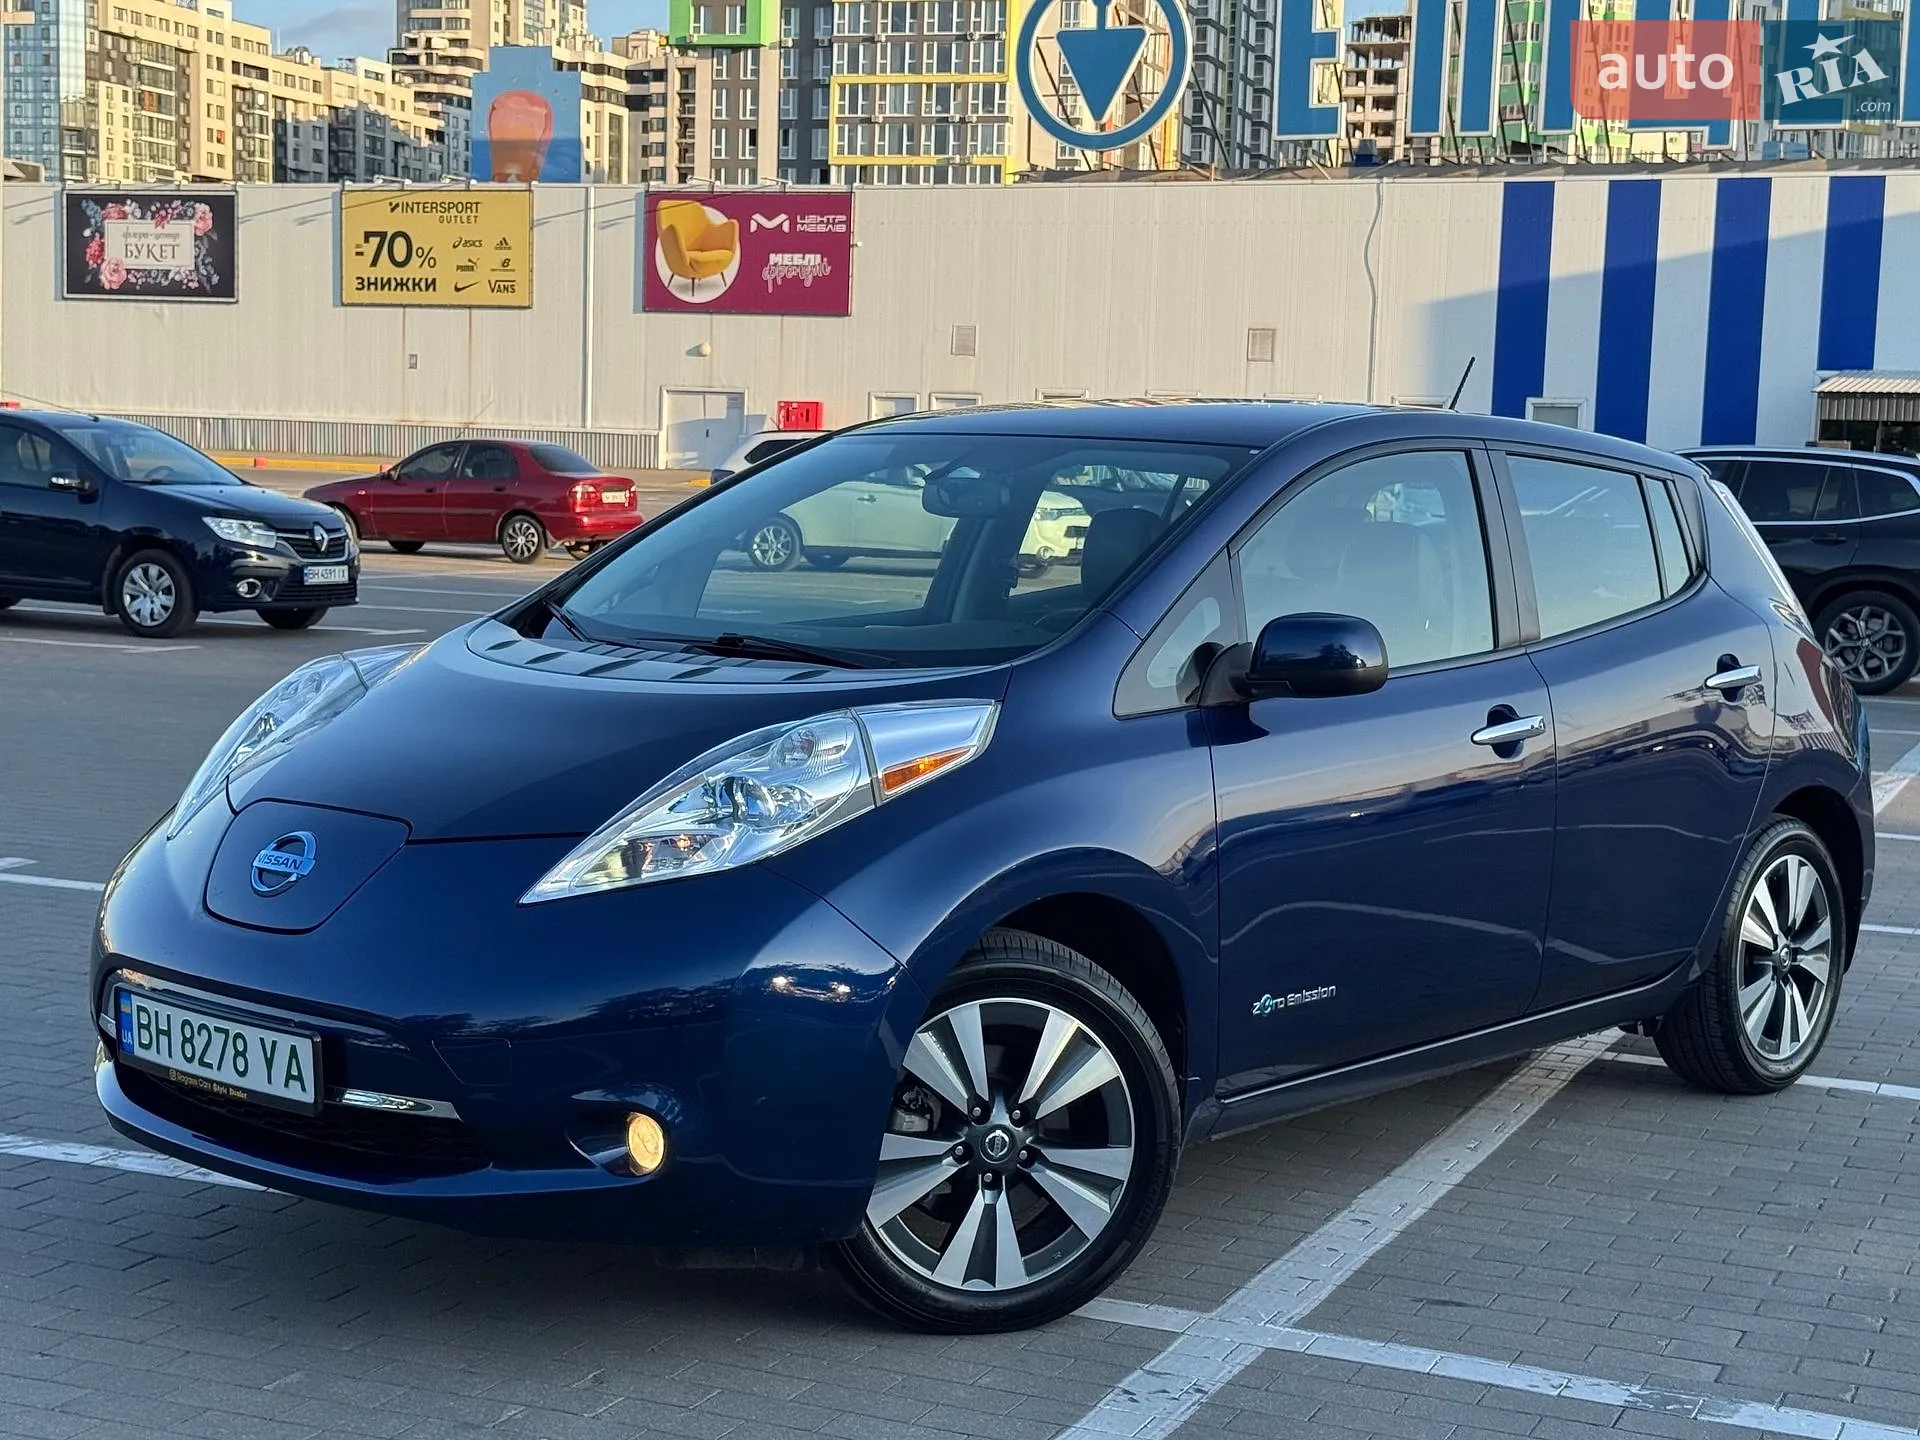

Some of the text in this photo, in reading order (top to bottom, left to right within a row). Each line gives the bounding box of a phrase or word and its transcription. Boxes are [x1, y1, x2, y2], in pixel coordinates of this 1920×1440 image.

[401, 201, 481, 214] INTERSPORT
[438, 215, 479, 224] OUTLET
[796, 215, 847, 224] ЦЕНТР
[124, 244, 180, 262] БУКЕТ
[355, 276, 437, 292] ЗНИЖКИ
[258, 853, 303, 871] NISSAN
[1286, 985, 1337, 1006] Emission
[121, 1028, 133, 1046] UA
[136, 1004, 307, 1093] BH 8278 YA
